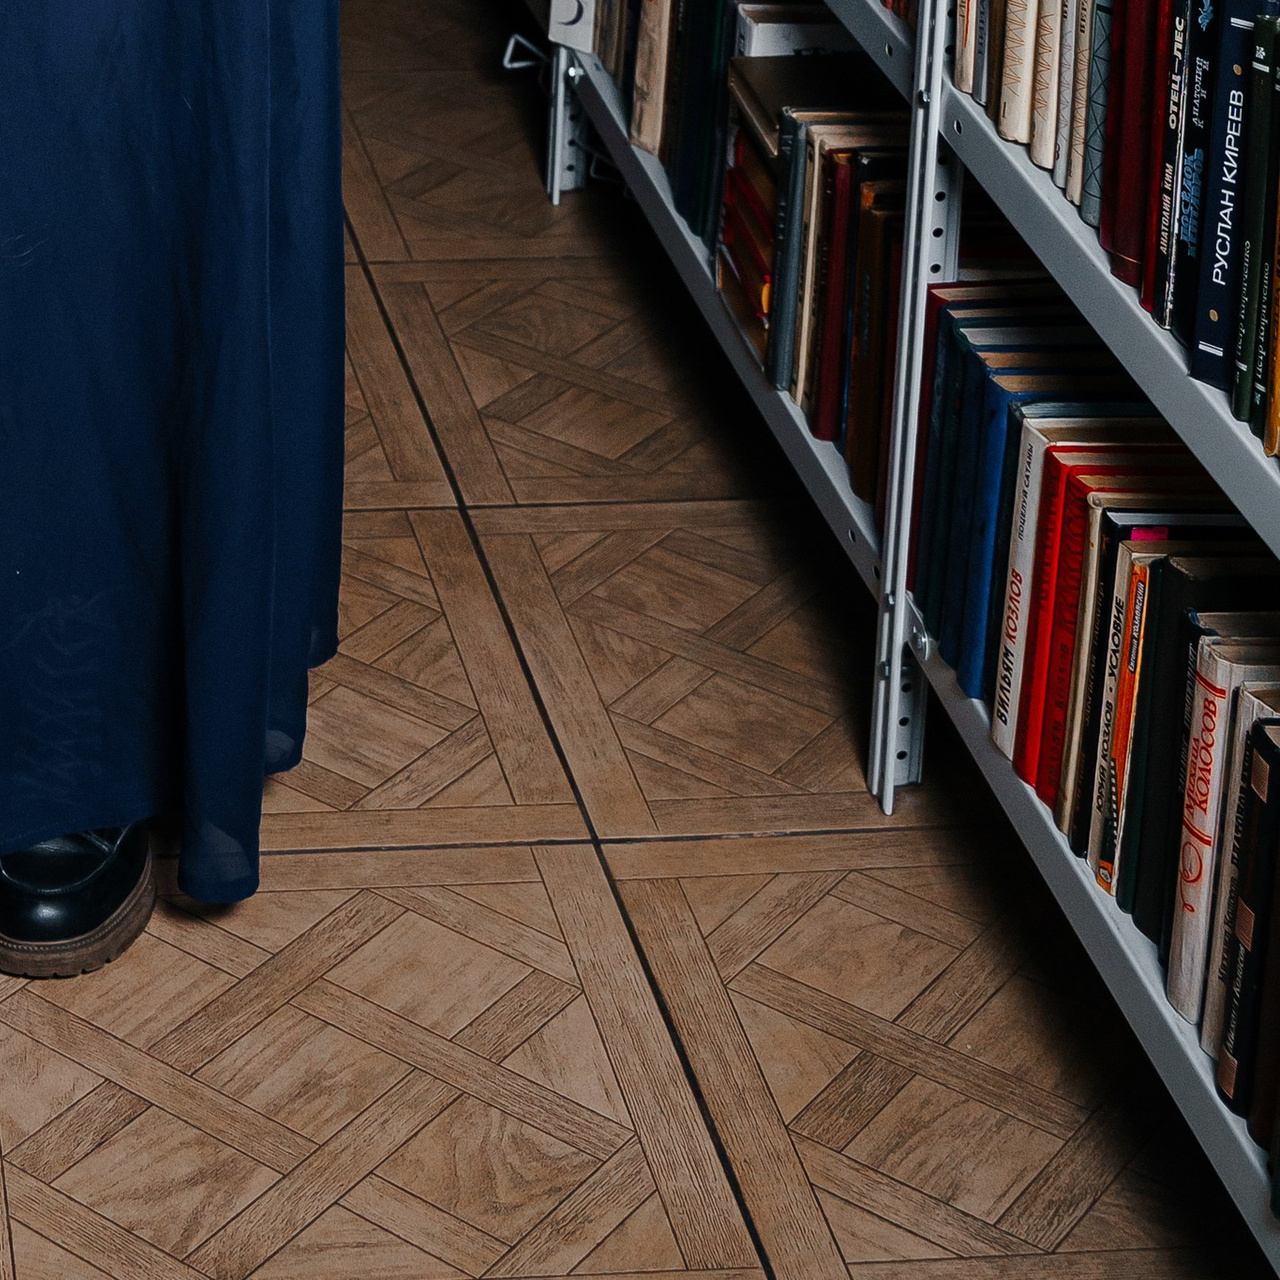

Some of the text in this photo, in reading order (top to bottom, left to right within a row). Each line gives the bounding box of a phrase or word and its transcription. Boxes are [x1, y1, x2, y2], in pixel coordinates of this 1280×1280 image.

[1158, 163, 1174, 255] АНАТОЛИЙ КИМ
[1213, 89, 1245, 286] РУСЛАН КИРЕЕВ
[995, 442, 1034, 727] ВИЛЬЯМ КОЗЛОВ ПОЦЕЛУЙ САТАНЫ
[1131, 580, 1145, 638] КОЗЛОВСКИЙ
[1095, 595, 1125, 814] ЮРИЙ КОЗЛОВ УСЛОВИЕ
[1182, 696, 1218, 819] Михаил КОЛОСОВ
